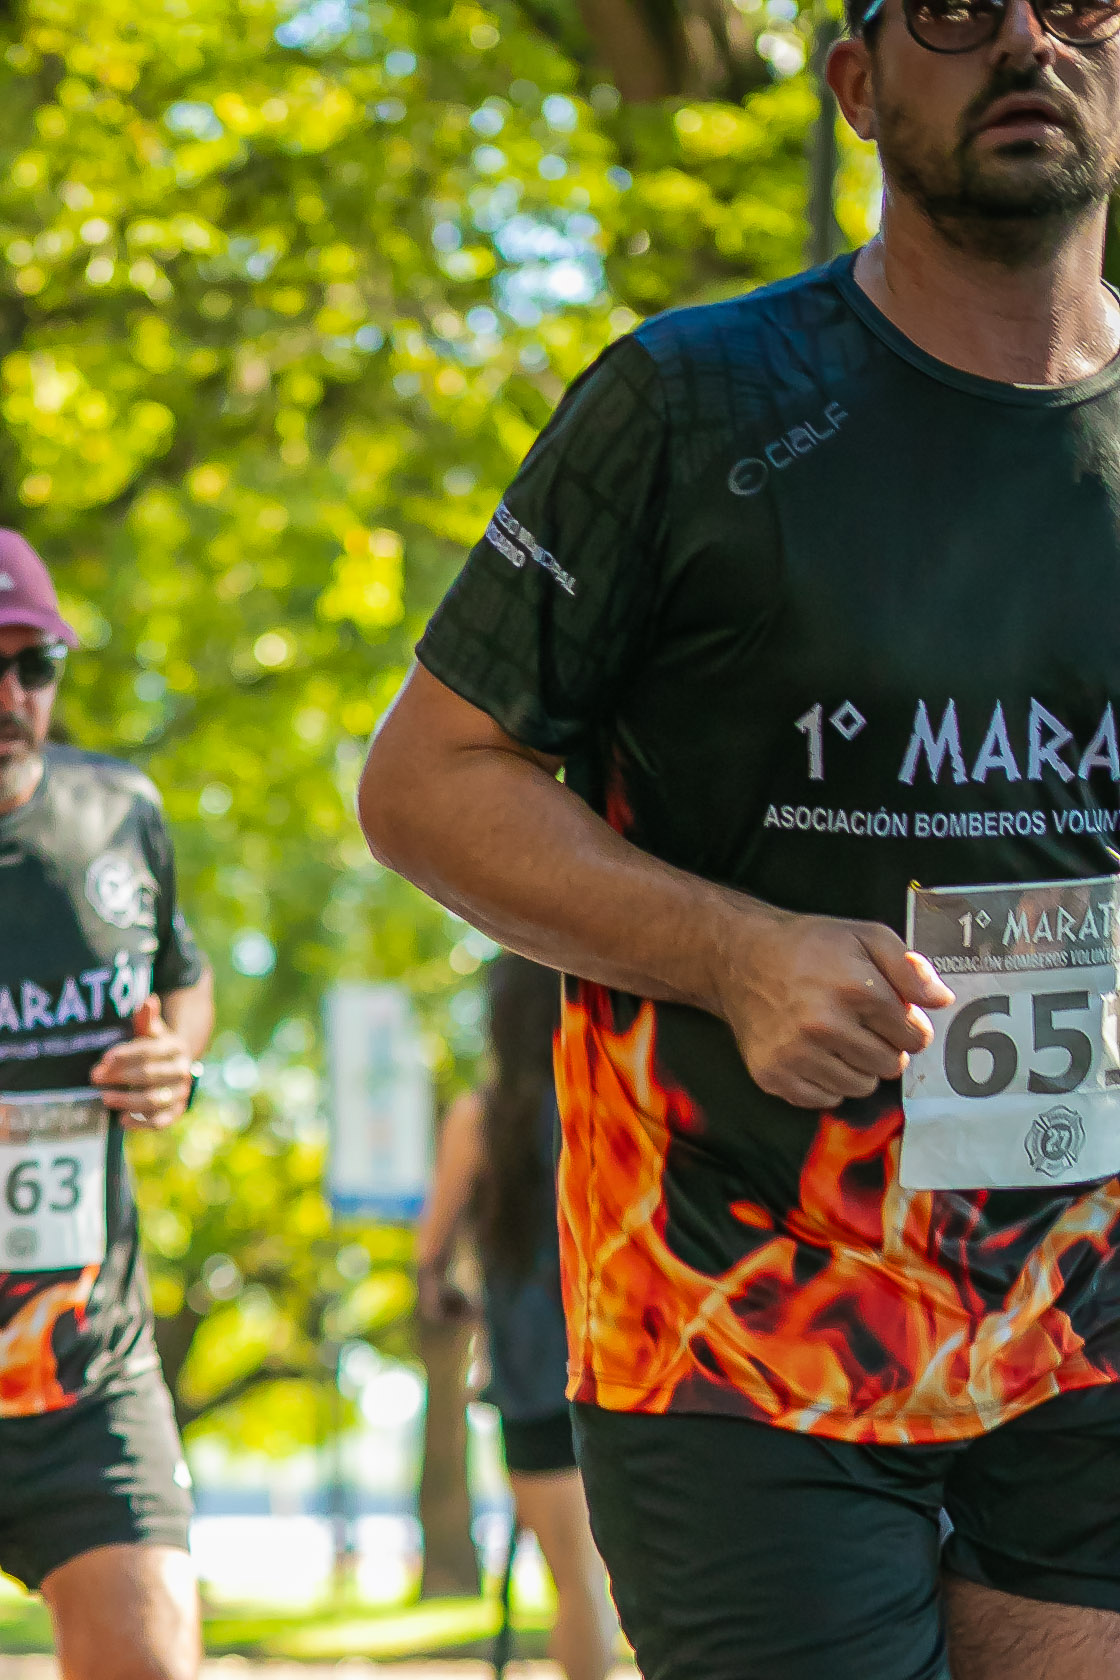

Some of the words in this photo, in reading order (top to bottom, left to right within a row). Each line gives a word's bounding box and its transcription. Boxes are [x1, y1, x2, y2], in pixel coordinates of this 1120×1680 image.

[897, 696, 1120, 785] MARA
[763, 804, 908, 837] ASOCIACIÓN
[914, 810, 1047, 838] BOMBEROS
[1051, 808, 1120, 835] VOLUN
[944, 990, 1120, 1099] 65
